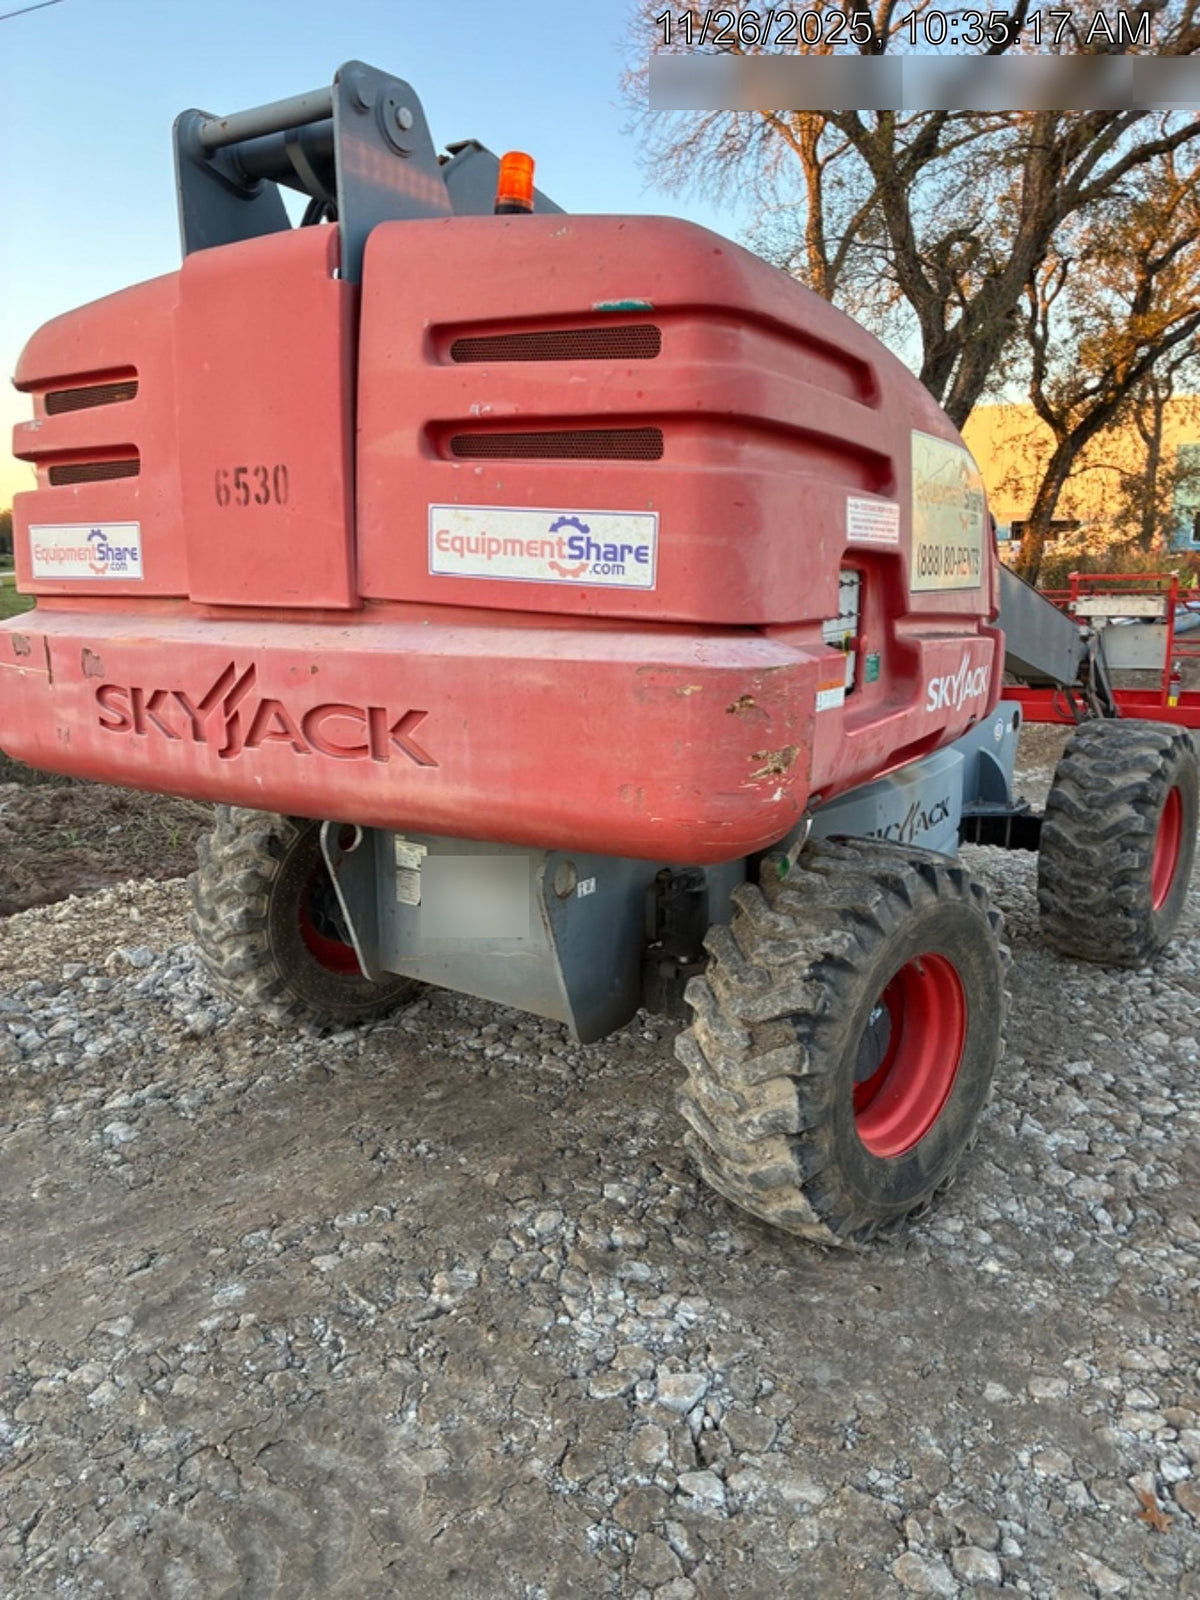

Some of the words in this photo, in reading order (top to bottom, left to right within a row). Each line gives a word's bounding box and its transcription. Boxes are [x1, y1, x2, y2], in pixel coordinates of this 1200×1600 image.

[214, 464, 289, 507] 6530
[34, 543, 139, 565] EquipmentShare
[435, 529, 650, 564] EquipmentShare
[588, 563, 626, 576] .com
[926, 652, 990, 712] SKYJACK
[95, 660, 439, 768] SKYJACK
